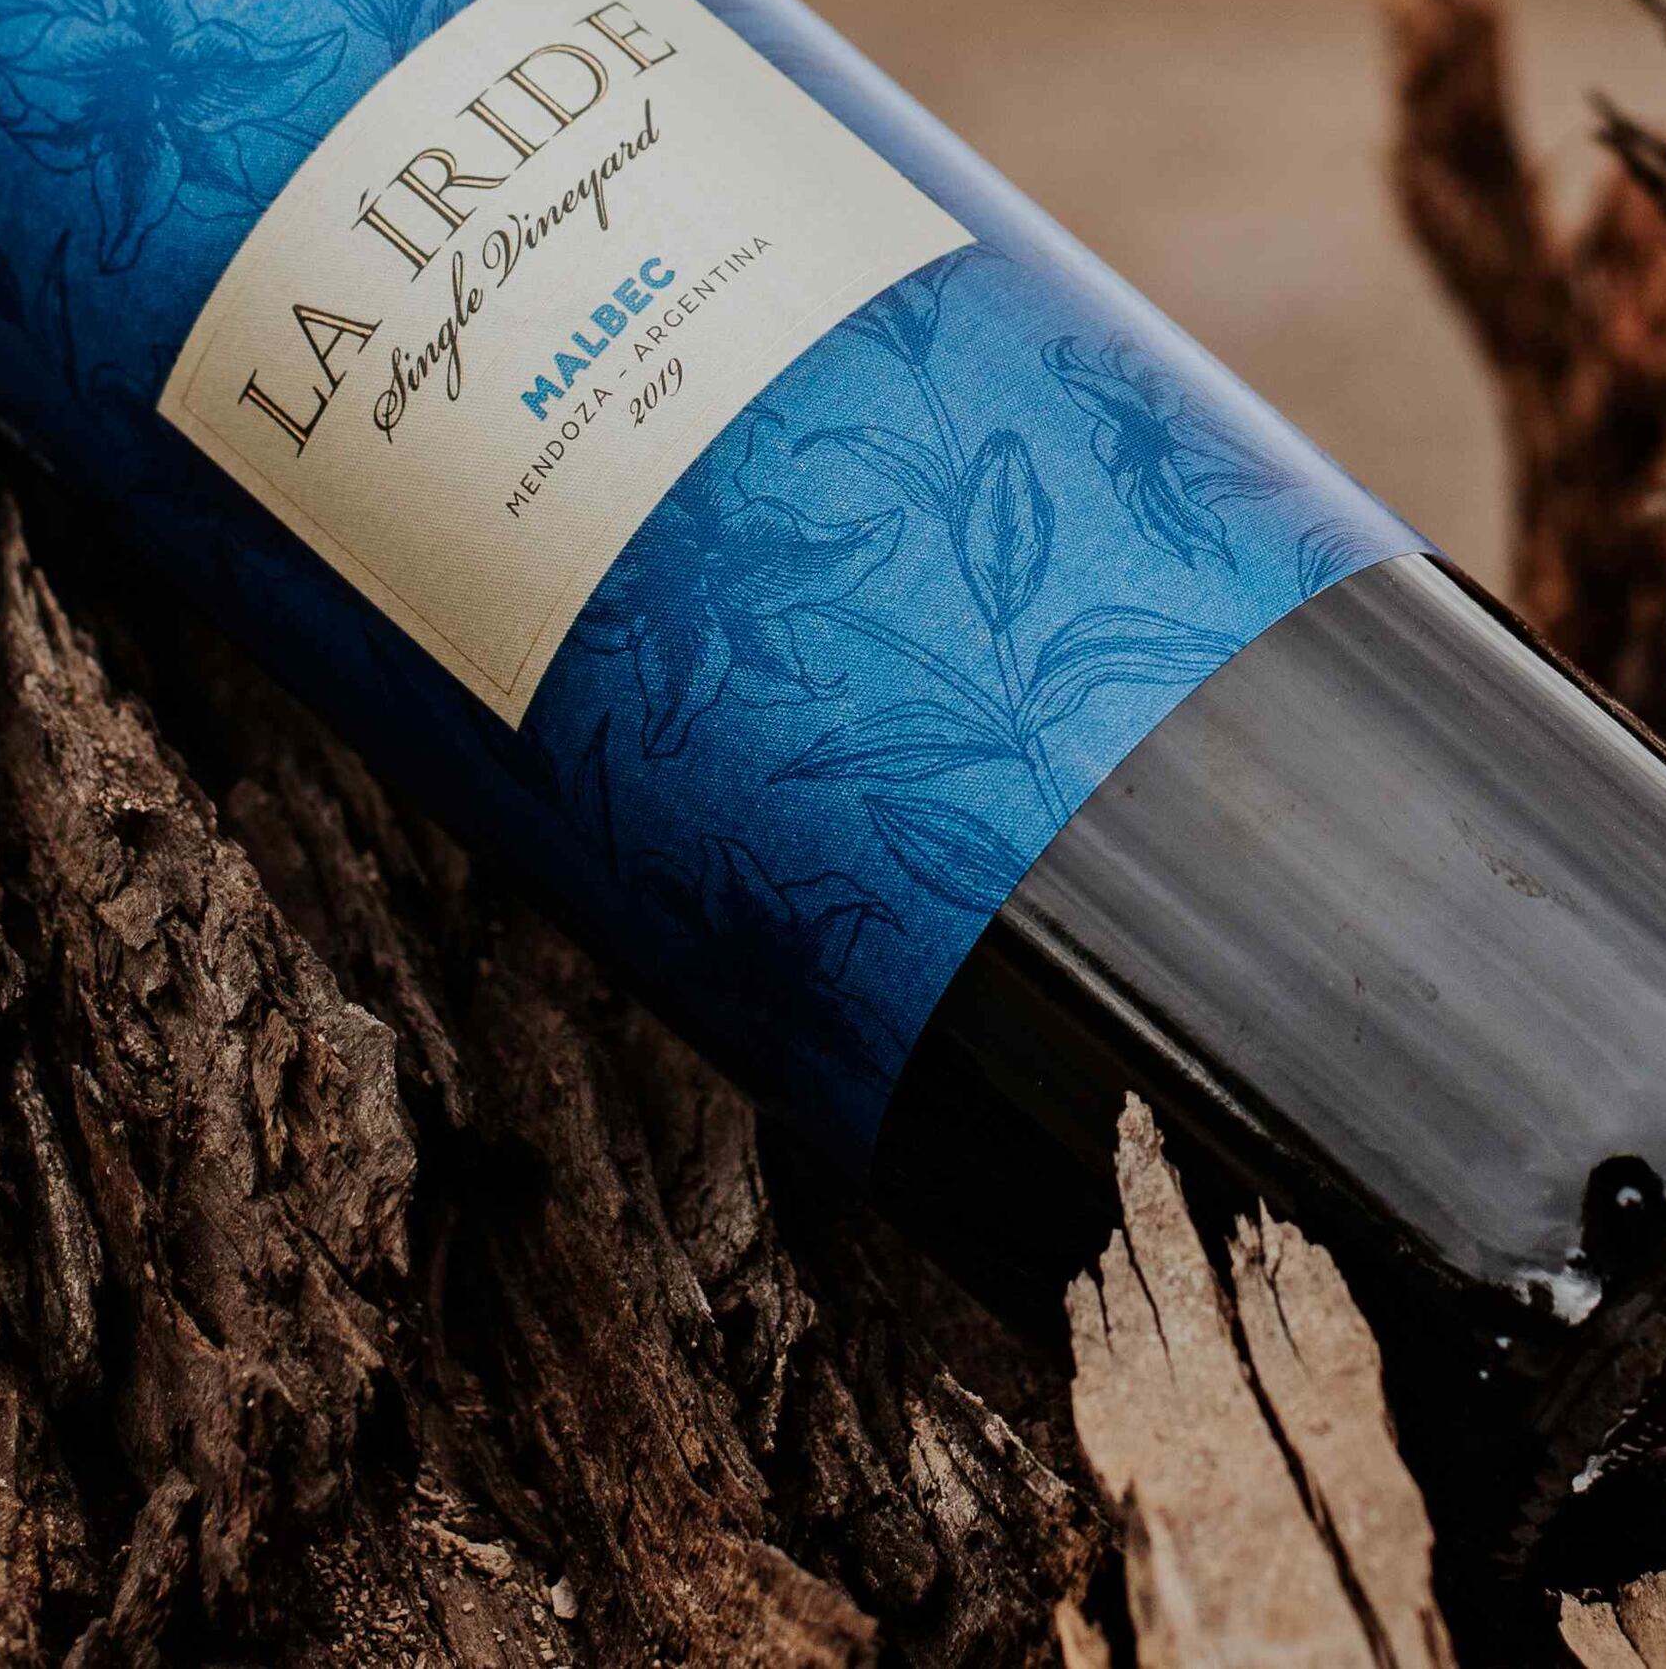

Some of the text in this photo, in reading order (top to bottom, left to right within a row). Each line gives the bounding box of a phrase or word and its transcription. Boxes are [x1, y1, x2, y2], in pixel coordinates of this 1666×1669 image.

[238, 0, 679, 458] LA ÍRIDE
[372, 99, 661, 444] Single Vineyard
[520, 255, 679, 420] MALBEC
[505, 385, 613, 520] MENDOZA
[632, 236, 773, 364] ARGENTINA
[628, 357, 685, 429] 2019
